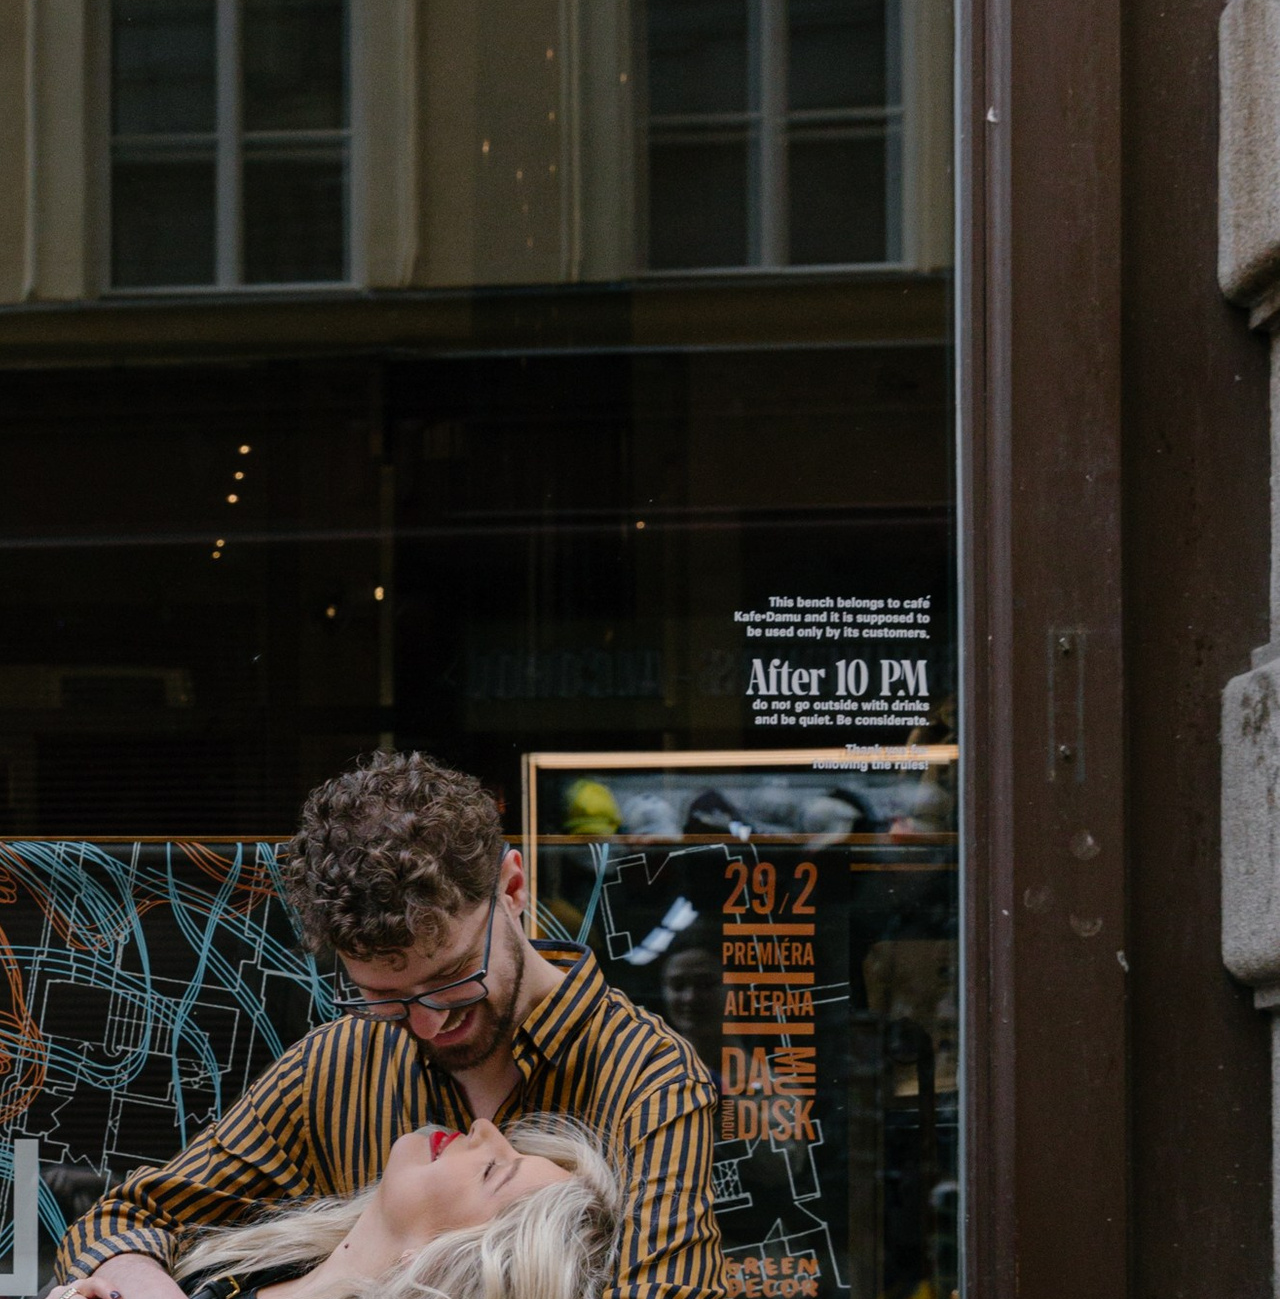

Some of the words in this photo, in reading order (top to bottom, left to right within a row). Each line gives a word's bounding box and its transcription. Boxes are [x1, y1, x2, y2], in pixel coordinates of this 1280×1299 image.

[769, 597, 794, 608] This
[797, 597, 833, 608] bench
[837, 597, 884, 610] belongs
[887, 598, 900, 608] to
[903, 595, 931, 609] café
[804, 612, 827, 623] and
[830, 612, 839, 623] it
[843, 612, 853, 623] is
[856, 613, 913, 625] supposed
[917, 614, 930, 623] to
[747, 626, 762, 637] be
[765, 627, 794, 637] used
[797, 627, 822, 639] only
[826, 627, 840, 640] by
[844, 627, 859, 637] its
[862, 628, 930, 638] customers.
[746, 659, 826, 696] After
[835, 659, 868, 696] 10
[880, 659, 929, 696] PM
[753, 699, 767, 710] do
[795, 701, 809, 714] go
[813, 700, 858, 711] outside
[861, 700, 888, 711] with
[891, 700, 929, 711] drinks
[755, 714, 778, 725] and
[781, 714, 796, 725] be
[799, 715, 833, 727] quiet.
[837, 715, 852, 726] Be
[855, 715, 929, 726] considerate.
[813, 760, 868, 772] following
[872, 761, 891, 770] the
[895, 761, 928, 770] rules!
[722, 938, 815, 965] PREMIÉRA
[724, 991, 815, 1016] ALTERNA
[722, 1100, 735, 1140] DIVADLO
[738, 1100, 815, 1140] DISK
[725, 1257, 819, 1276] GREEN
[726, 1278, 819, 1298] DECOR
